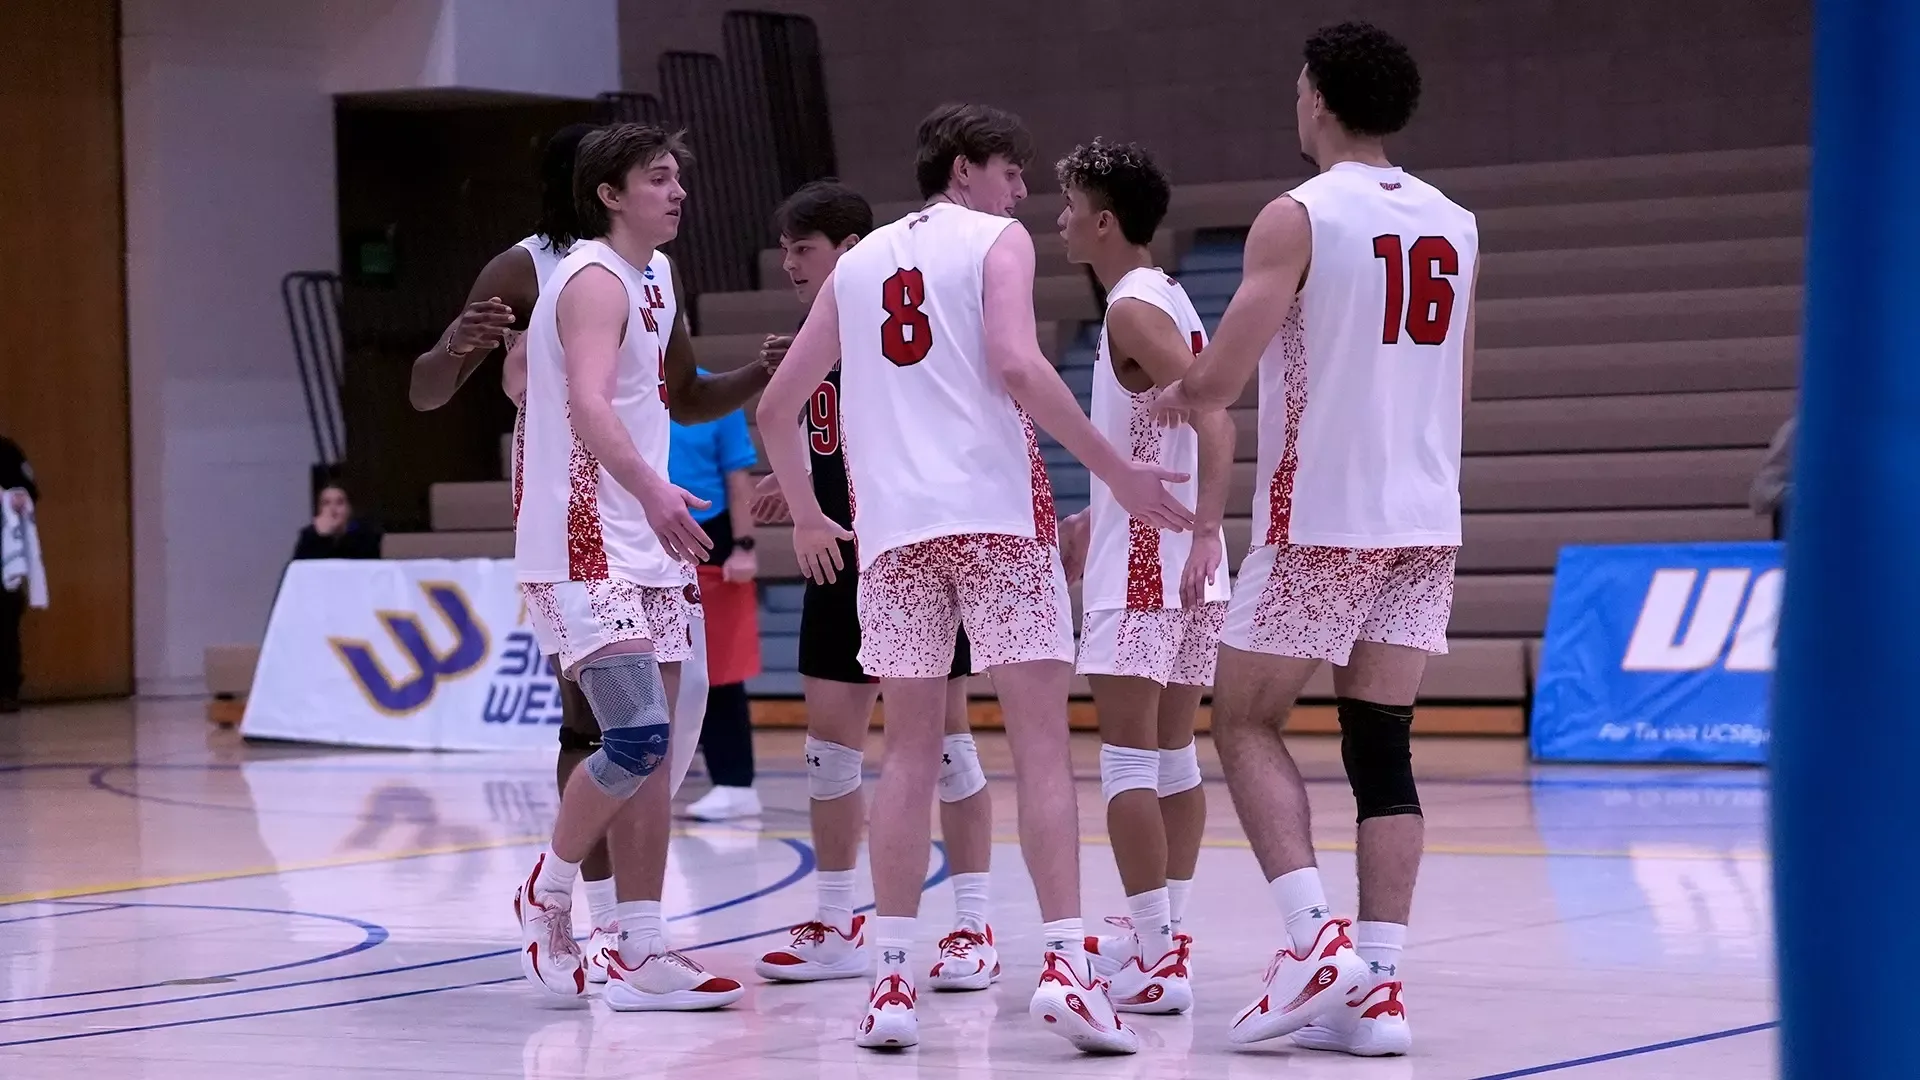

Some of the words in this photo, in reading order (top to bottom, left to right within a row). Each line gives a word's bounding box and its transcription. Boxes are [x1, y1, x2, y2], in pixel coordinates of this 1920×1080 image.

[880, 267, 933, 367] 8
[1373, 234, 1459, 345] 16
[809, 380, 839, 456] 9
